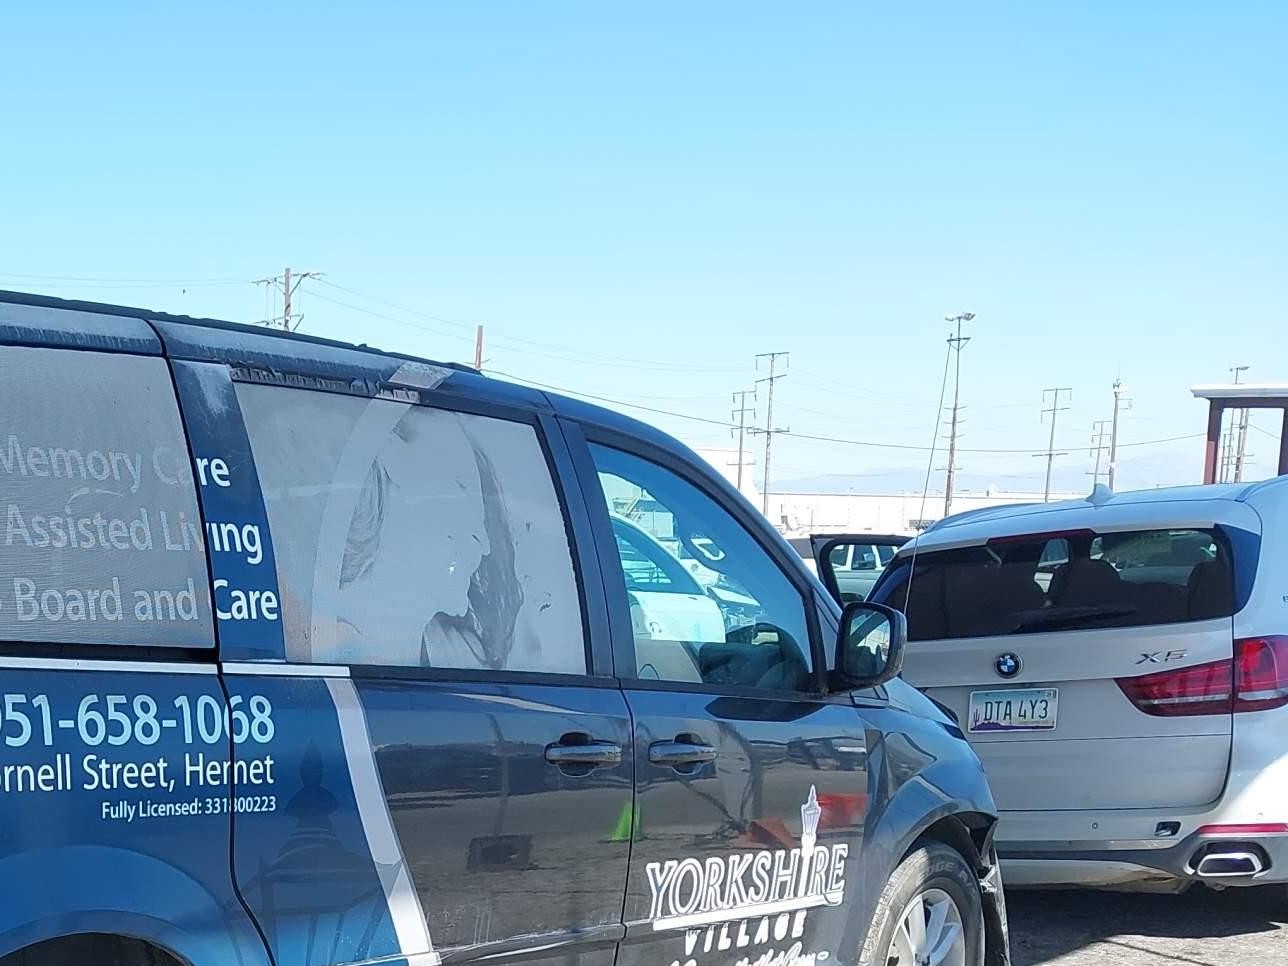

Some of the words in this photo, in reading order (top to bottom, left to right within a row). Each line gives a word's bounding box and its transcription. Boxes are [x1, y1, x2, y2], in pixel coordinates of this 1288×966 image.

[152, 446, 231, 488] Care
[5, 503, 153, 550] Assisted
[160, 509, 263, 565] Living
[12, 576, 123, 622] Board
[133, 577, 199, 622] and
[207, 578, 278, 621] Care
[1136, 650, 1188, 665] X5
[983, 700, 1013, 722] DTA
[1017, 698, 1050, 720] 4Y3
[83, 753, 176, 792] Street,
[184, 752, 275, 787] Hemet
[102, 801, 136, 823] Fully
[139, 798, 202, 818] Licensed:
[645, 843, 849, 919] YORKSHIRE
